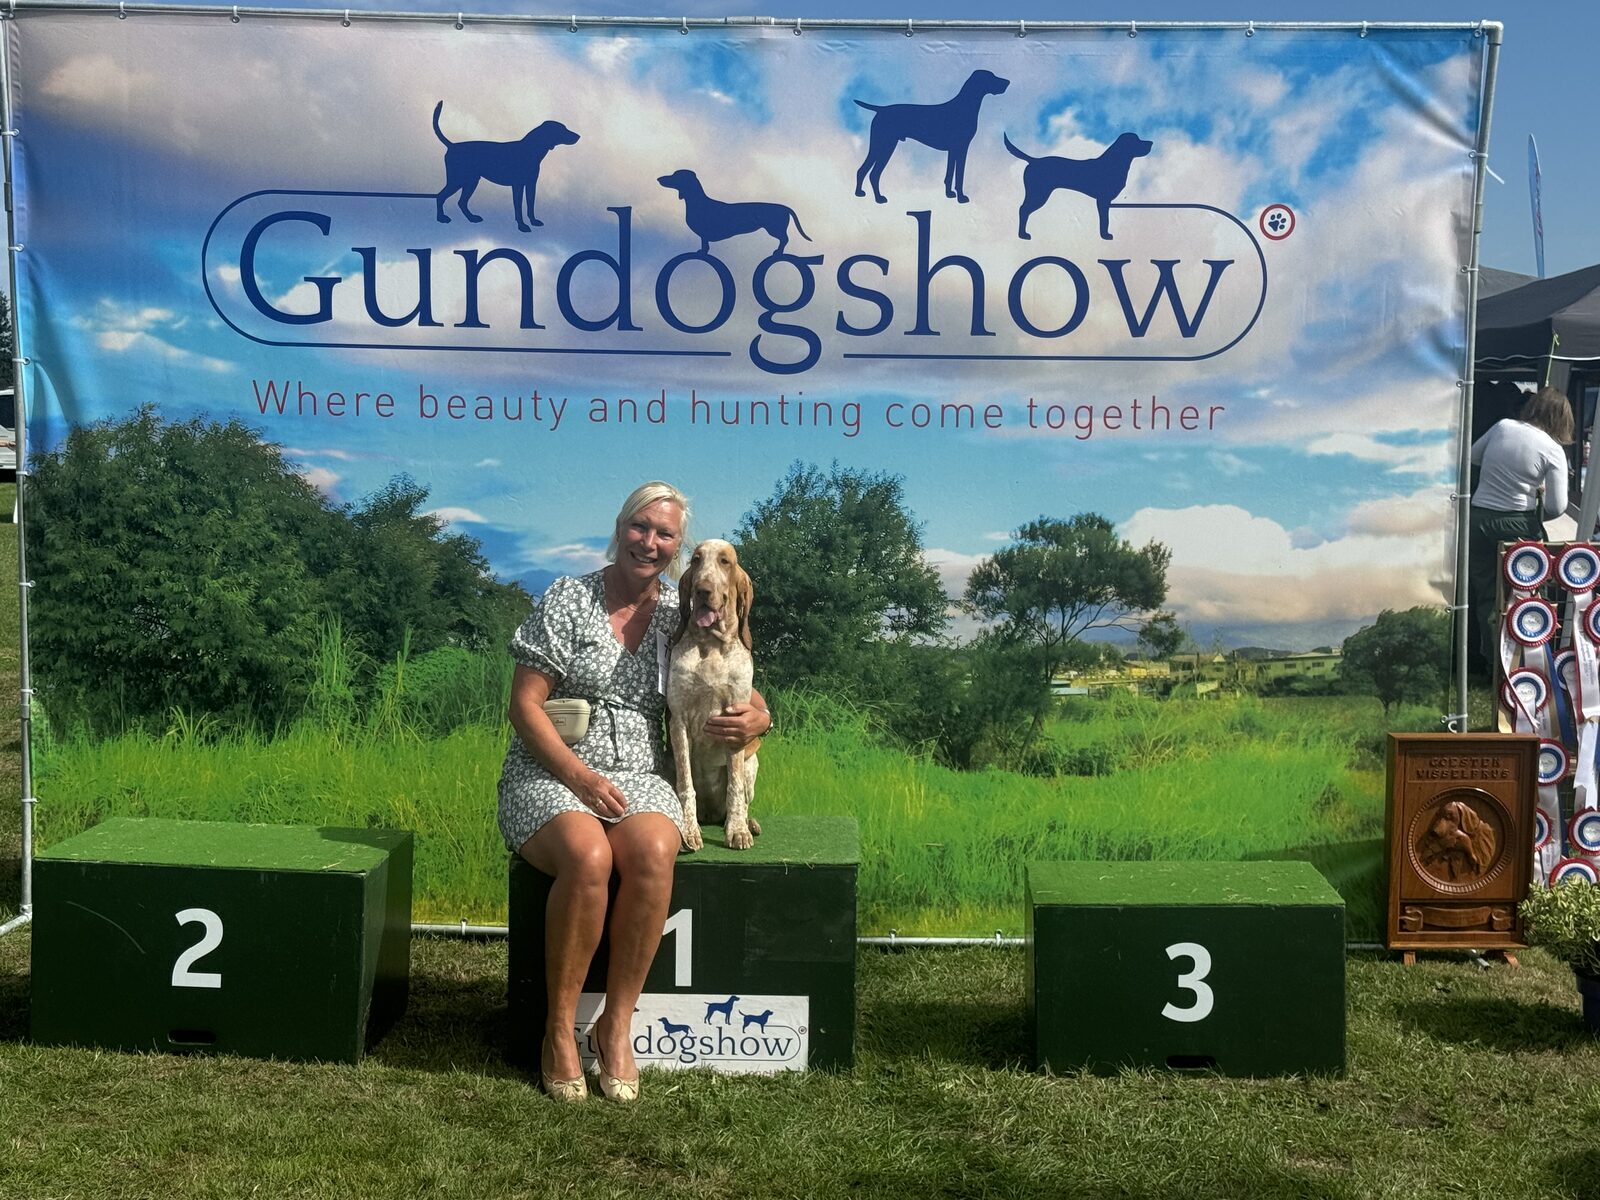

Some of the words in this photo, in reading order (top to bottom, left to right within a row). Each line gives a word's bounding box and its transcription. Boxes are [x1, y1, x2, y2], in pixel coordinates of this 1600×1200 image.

[239, 206, 1235, 375] Gundogshow
[252, 379, 395, 419] Where
[418, 384, 568, 431] beauty
[588, 389, 667, 424] and
[690, 390, 863, 438] hunting
[885, 397, 1004, 429] come
[1027, 396, 1226, 440] together
[171, 907, 224, 989] 2
[662, 908, 693, 987] 1
[1160, 942, 1214, 1023] 3
[574, 1025, 793, 1064] udogshow
